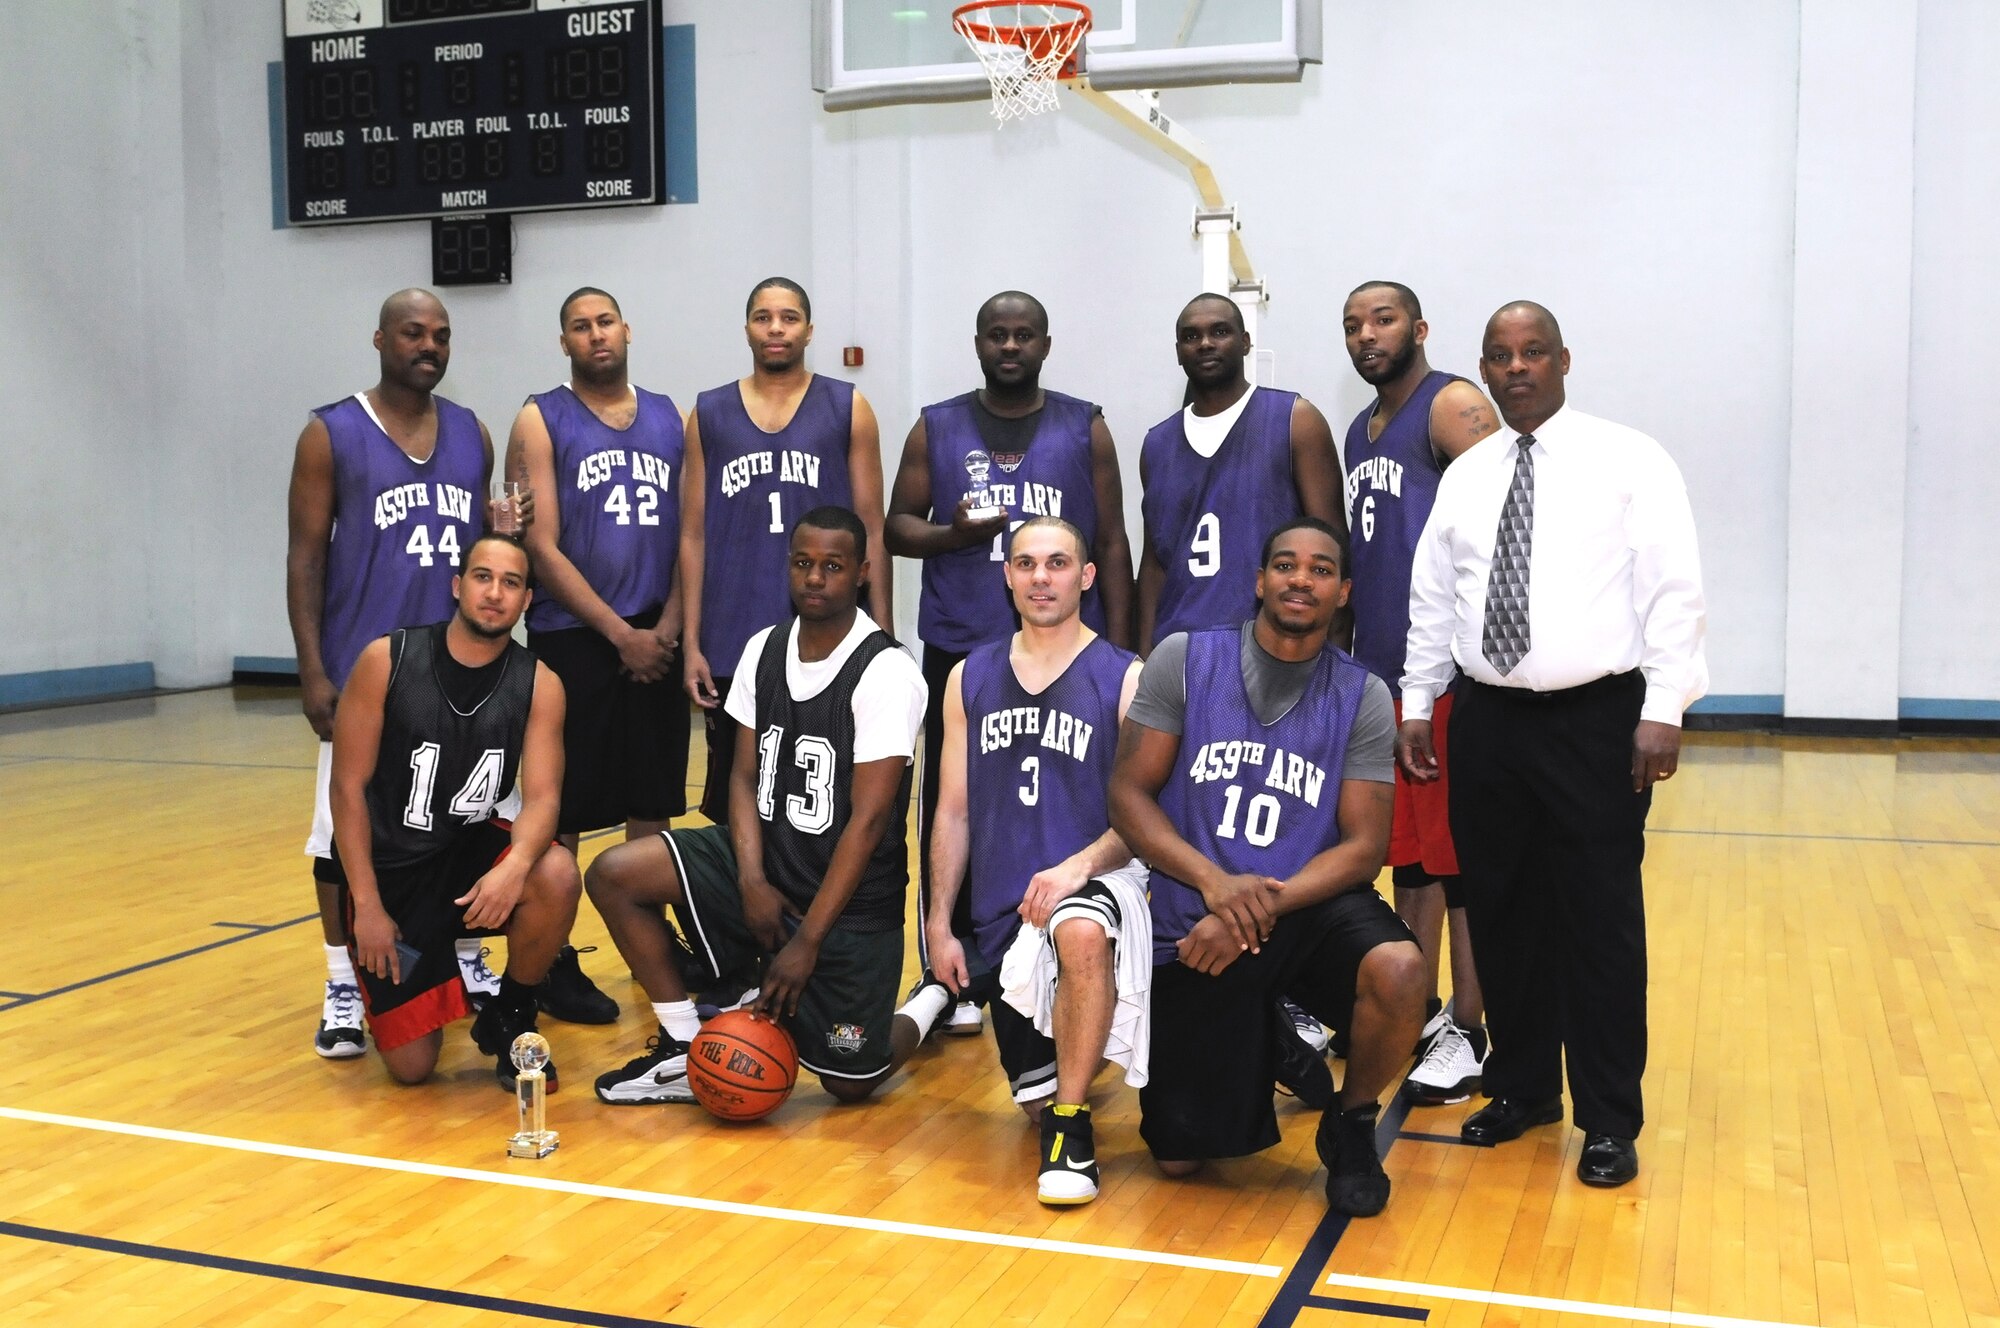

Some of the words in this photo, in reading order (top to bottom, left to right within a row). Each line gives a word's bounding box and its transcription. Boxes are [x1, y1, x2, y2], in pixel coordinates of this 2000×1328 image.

[567, 8, 635, 38] GUEST
[311, 36, 366, 63] HOME
[434, 43, 484, 62] PERIOD
[361, 126, 399, 143] T.O.L.
[413, 119, 465, 139] PLAYER
[476, 116, 511, 134] FOUL
[527, 112, 568, 129] T.O.L.
[585, 106, 630, 125] FOULS
[304, 130, 345, 148] FOULS
[306, 199, 347, 217] SCORE
[441, 189, 488, 208] MATCH
[586, 179, 632, 198] SCORE
[577, 449, 627, 493] 459TH
[632, 451, 671, 493] ARW
[721, 451, 773, 498] 459TH
[780, 450, 821, 489] ARW
[1370, 456, 1404, 498] ARW
[374, 483, 431, 531] 459TH
[436, 483, 472, 524] ARW
[604, 484, 660, 526] 42
[768, 491, 785, 534] 1
[1022, 481, 1063, 518] ARW
[1361, 495, 1376, 542] 6
[405, 524, 461, 567] 44
[1187, 511, 1221, 578] 9
[980, 706, 1040, 755] 459TH
[1040, 709, 1094, 763] ARW
[403, 741, 505, 832] 14
[756, 724, 837, 836] 13
[1018, 756, 1040, 807] 3
[1189, 740, 1267, 785] 459TH
[1264, 747, 1326, 809] ARW
[1216, 784, 1282, 848] 10
[699, 1041, 728, 1066] THE
[726, 1048, 767, 1082] ROCK
